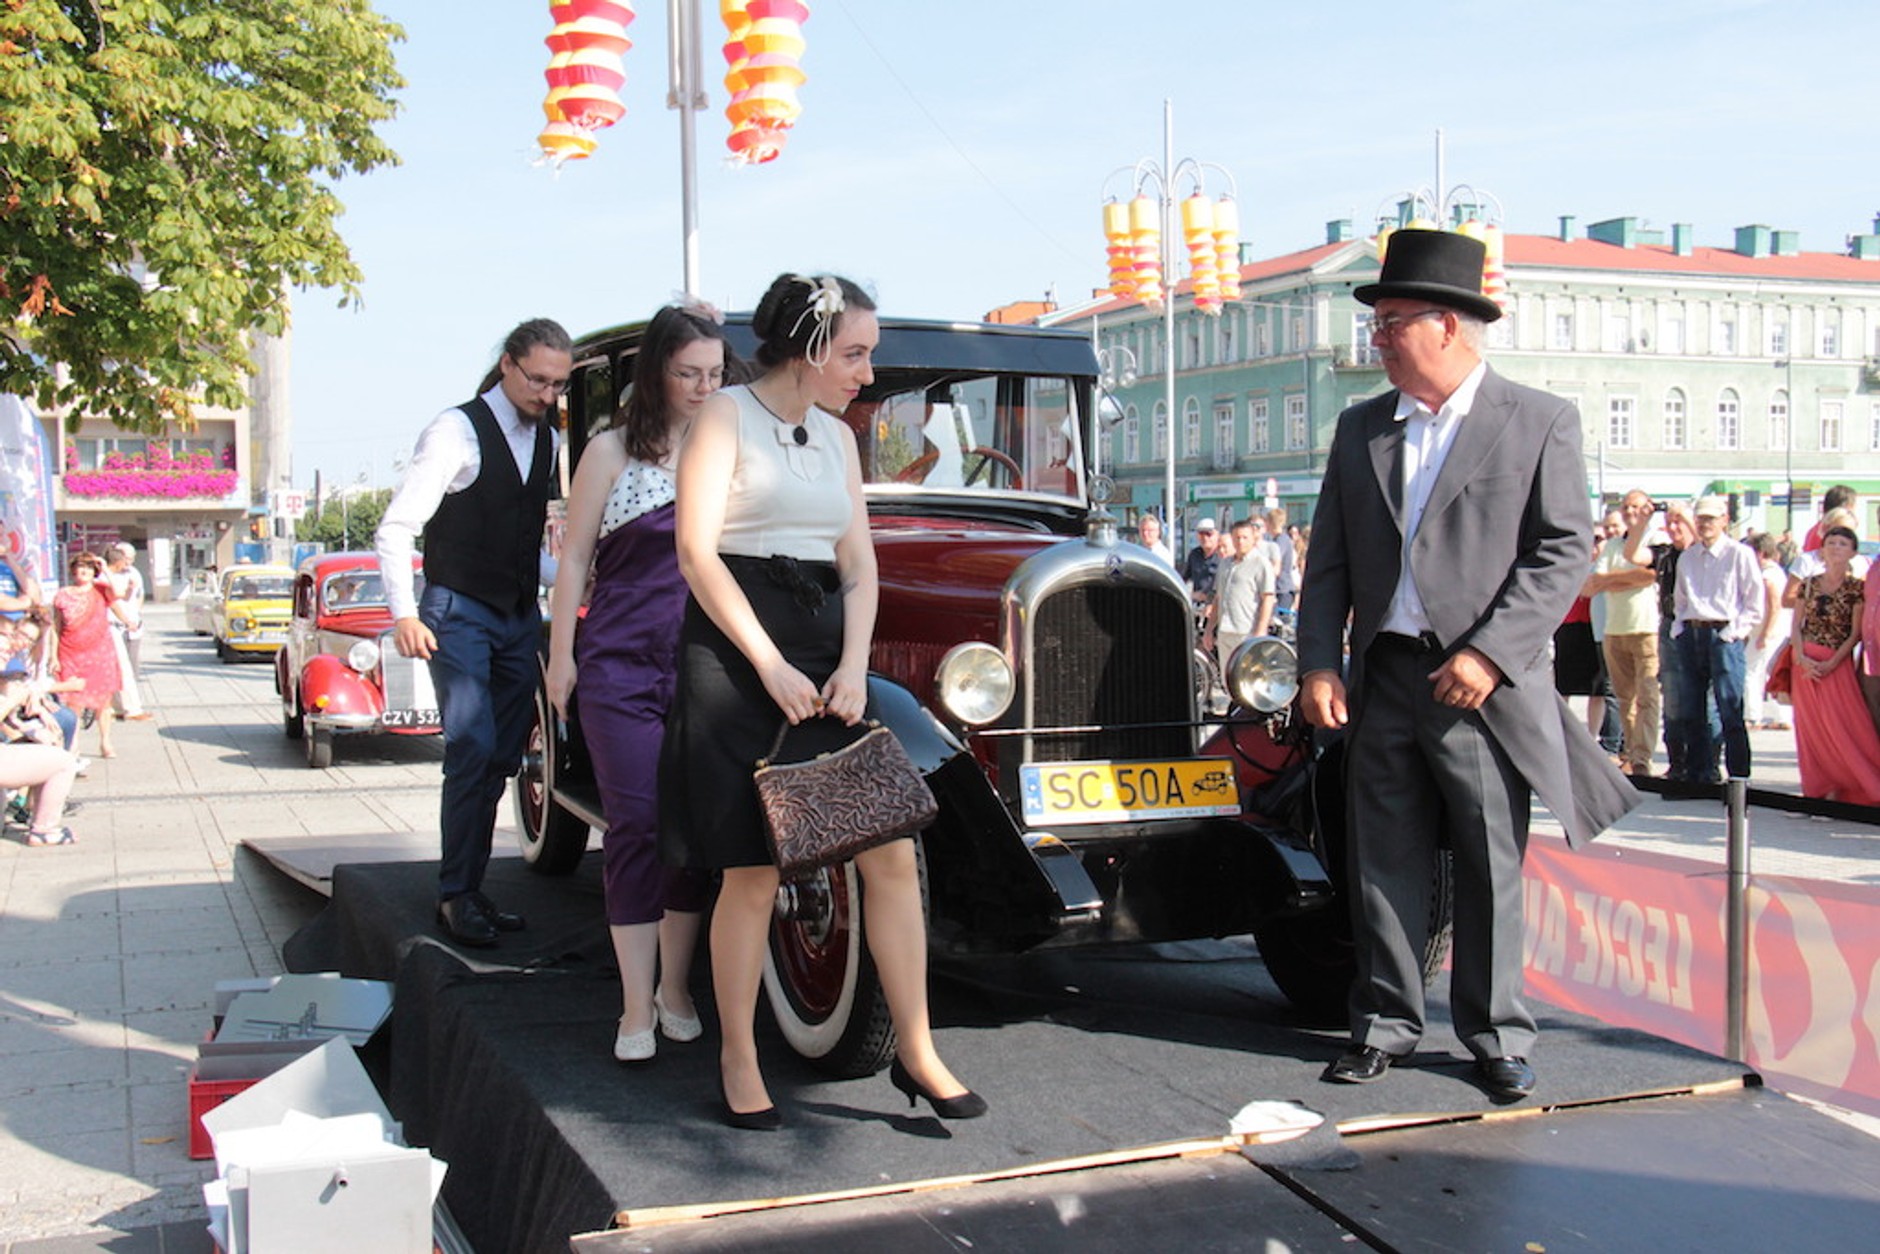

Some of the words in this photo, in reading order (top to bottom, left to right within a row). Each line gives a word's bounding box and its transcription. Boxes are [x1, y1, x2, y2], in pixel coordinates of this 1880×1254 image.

[381, 710, 413, 725] CZV
[1048, 769, 1103, 810] SC
[1115, 767, 1186, 807] 50A
